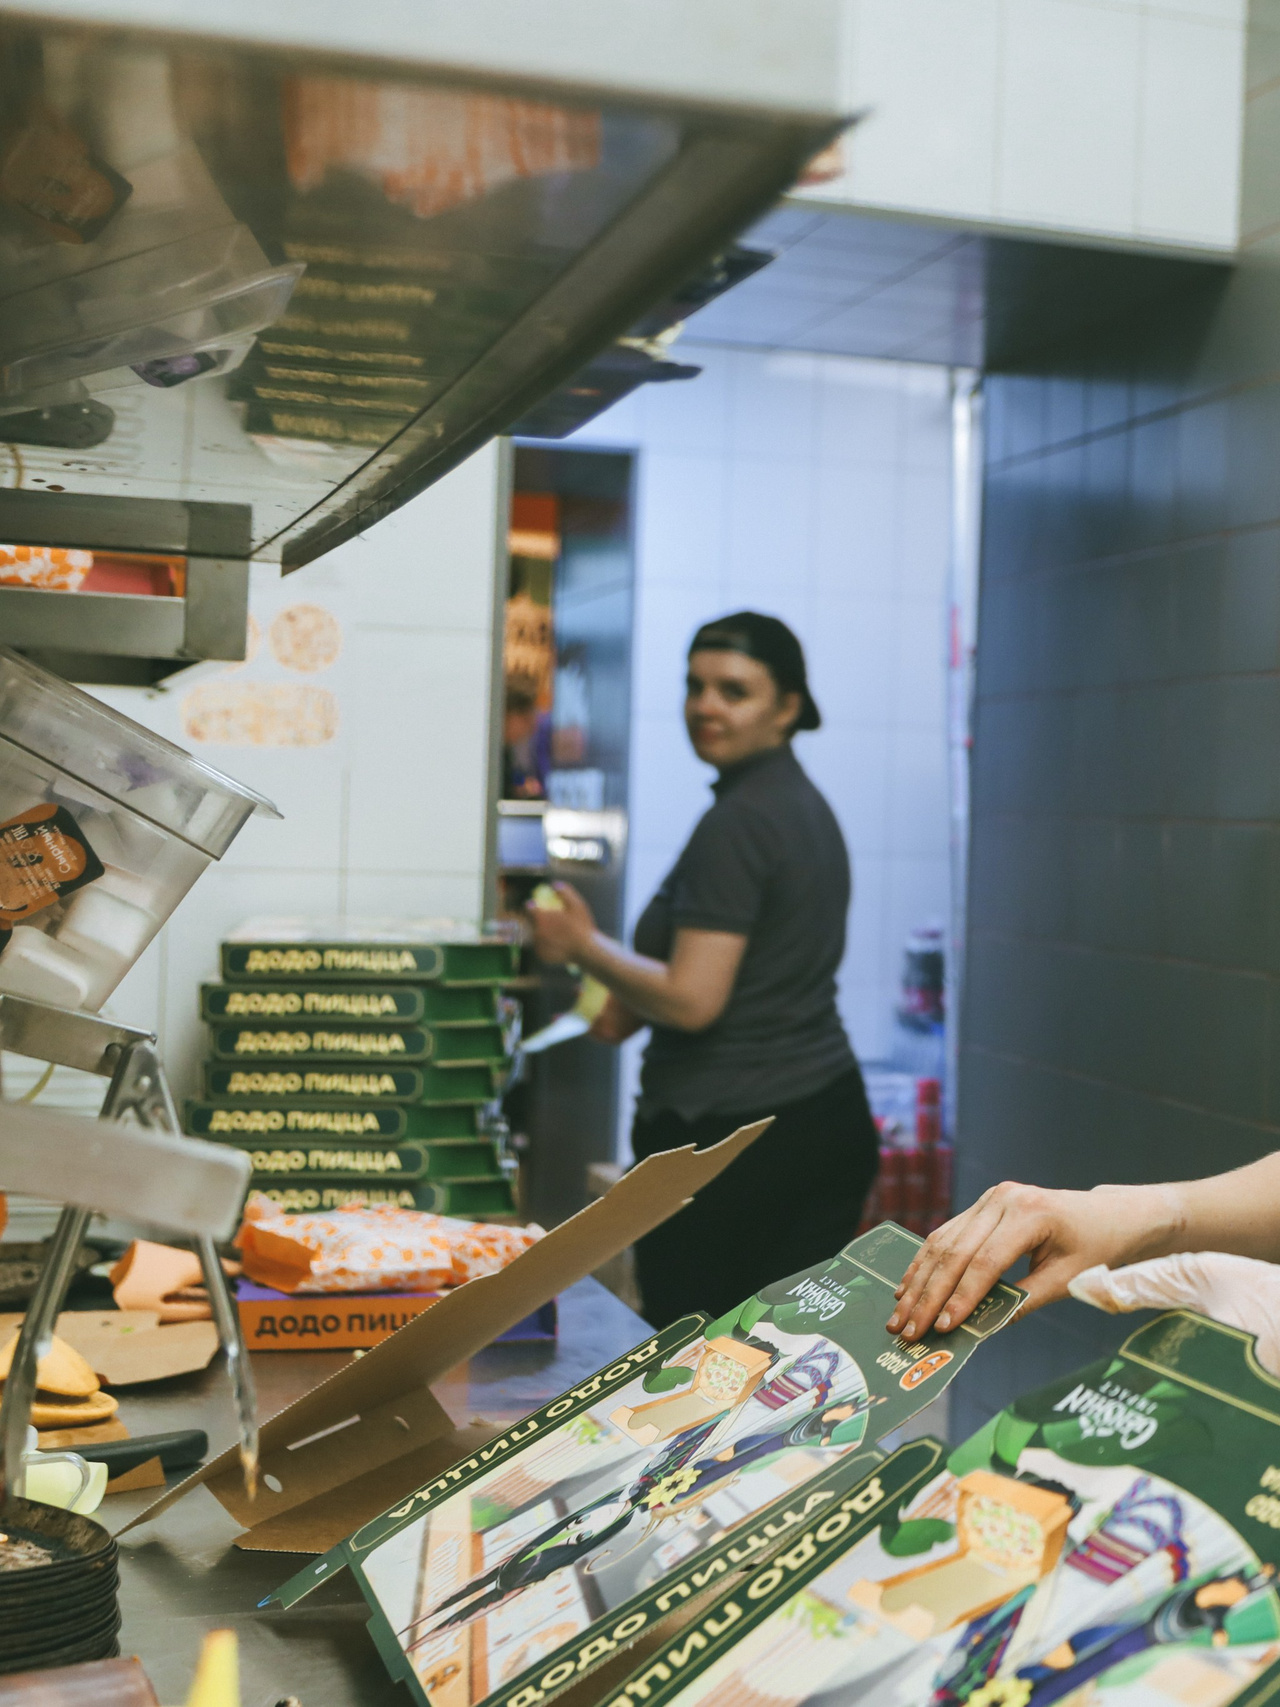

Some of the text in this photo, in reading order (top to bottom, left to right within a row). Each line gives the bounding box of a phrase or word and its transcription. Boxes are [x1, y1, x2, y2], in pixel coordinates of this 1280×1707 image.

[34, 825, 71, 874] Сырный
[245, 950, 417, 973] ДОДО ПИЦЦА
[225, 993, 397, 1017] ДОДО ПИЦЦА
[235, 1031, 406, 1055] ДОДО ПИЦЦА
[227, 1072, 396, 1096] ДОДО ПИЦЦА
[209, 1110, 380, 1135] ДОДО ПИЦЦА
[251, 1150, 402, 1174] ОДО ПИЦЦА
[786, 1277, 846, 1321] GENSHIN
[819, 1276, 851, 1298] IMPACT
[255, 1314, 341, 1337] ДОДО
[876, 1351, 912, 1375] ДОДО
[1052, 1383, 1158, 1450] GENSHIN
[388, 1340, 659, 1518] ДОДО ПИЦЦА
[746, 1477, 886, 1599] ДОДО
[507, 1490, 835, 1707] ДОДО ПИЦЦА
